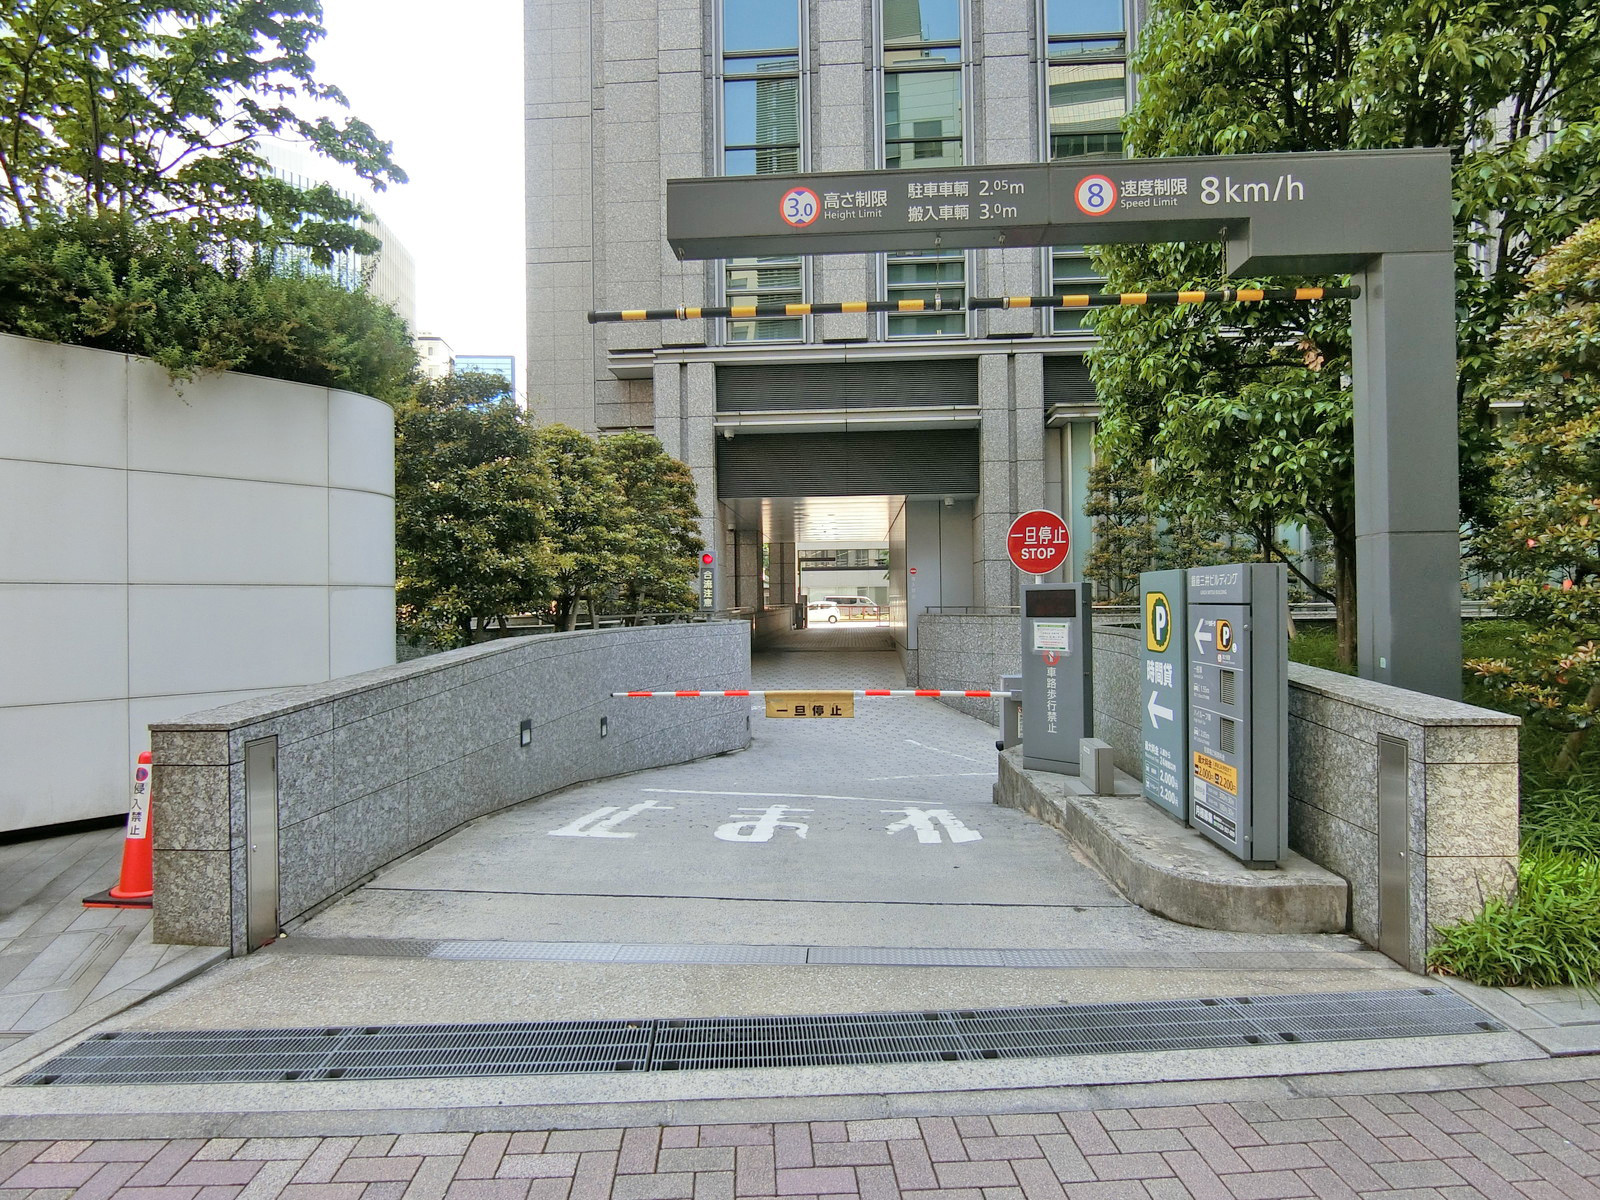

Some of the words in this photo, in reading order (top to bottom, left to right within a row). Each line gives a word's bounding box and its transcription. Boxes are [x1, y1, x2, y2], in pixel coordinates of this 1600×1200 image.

[908, 181, 969, 199] 駐車車輌
[979, 180, 1025, 196] 2.05m
[1087, 183, 1104, 208] 8
[1120, 178, 1188, 197] 速度制限
[1200, 174, 1304, 205] 8km/h
[787, 198, 813, 217] 3.0
[824, 190, 888, 209] 高さ制限
[1121, 199, 1150, 210] Speed
[1153, 198, 1178, 207] Limit
[824, 210, 856, 221] Height
[858, 209, 883, 218] Limit
[979, 203, 1018, 219] 3.0m
[1010, 526, 1067, 545] 一旦停止
[1021, 547, 1056, 560] STOP
[703, 570, 713, 607] 合流注意
[1155, 605, 1167, 641] P
[1222, 626, 1230, 646] P
[1146, 660, 1173, 688] 時間貸
[1046, 666, 1058, 734] 車路歩行禁止
[776, 705, 842, 716] 一旦停止
[129, 782, 145, 836] 侵入禁止
